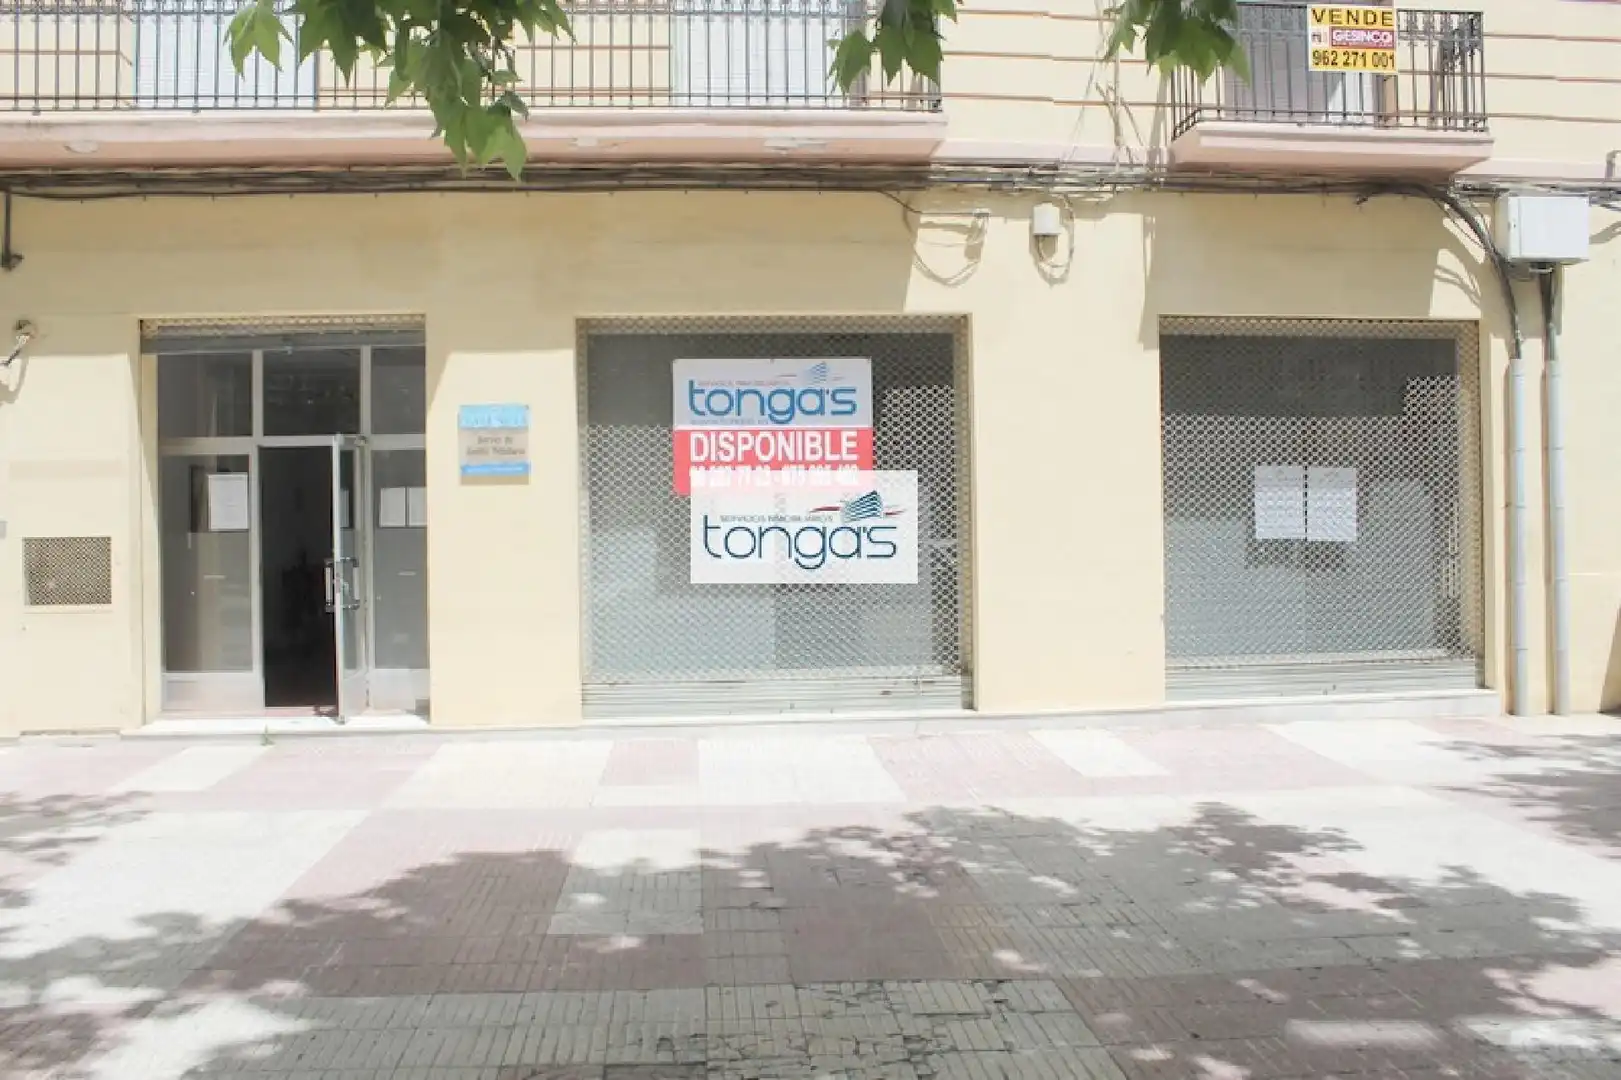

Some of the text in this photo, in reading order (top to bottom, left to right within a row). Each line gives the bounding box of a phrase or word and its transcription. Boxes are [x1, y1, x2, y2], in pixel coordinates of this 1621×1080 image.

[1311, 8, 1394, 26] VENDE
[1312, 50, 1395, 68] 962 271 001
[688, 379, 858, 424] tonga's
[689, 431, 858, 462] DISPONIBLE
